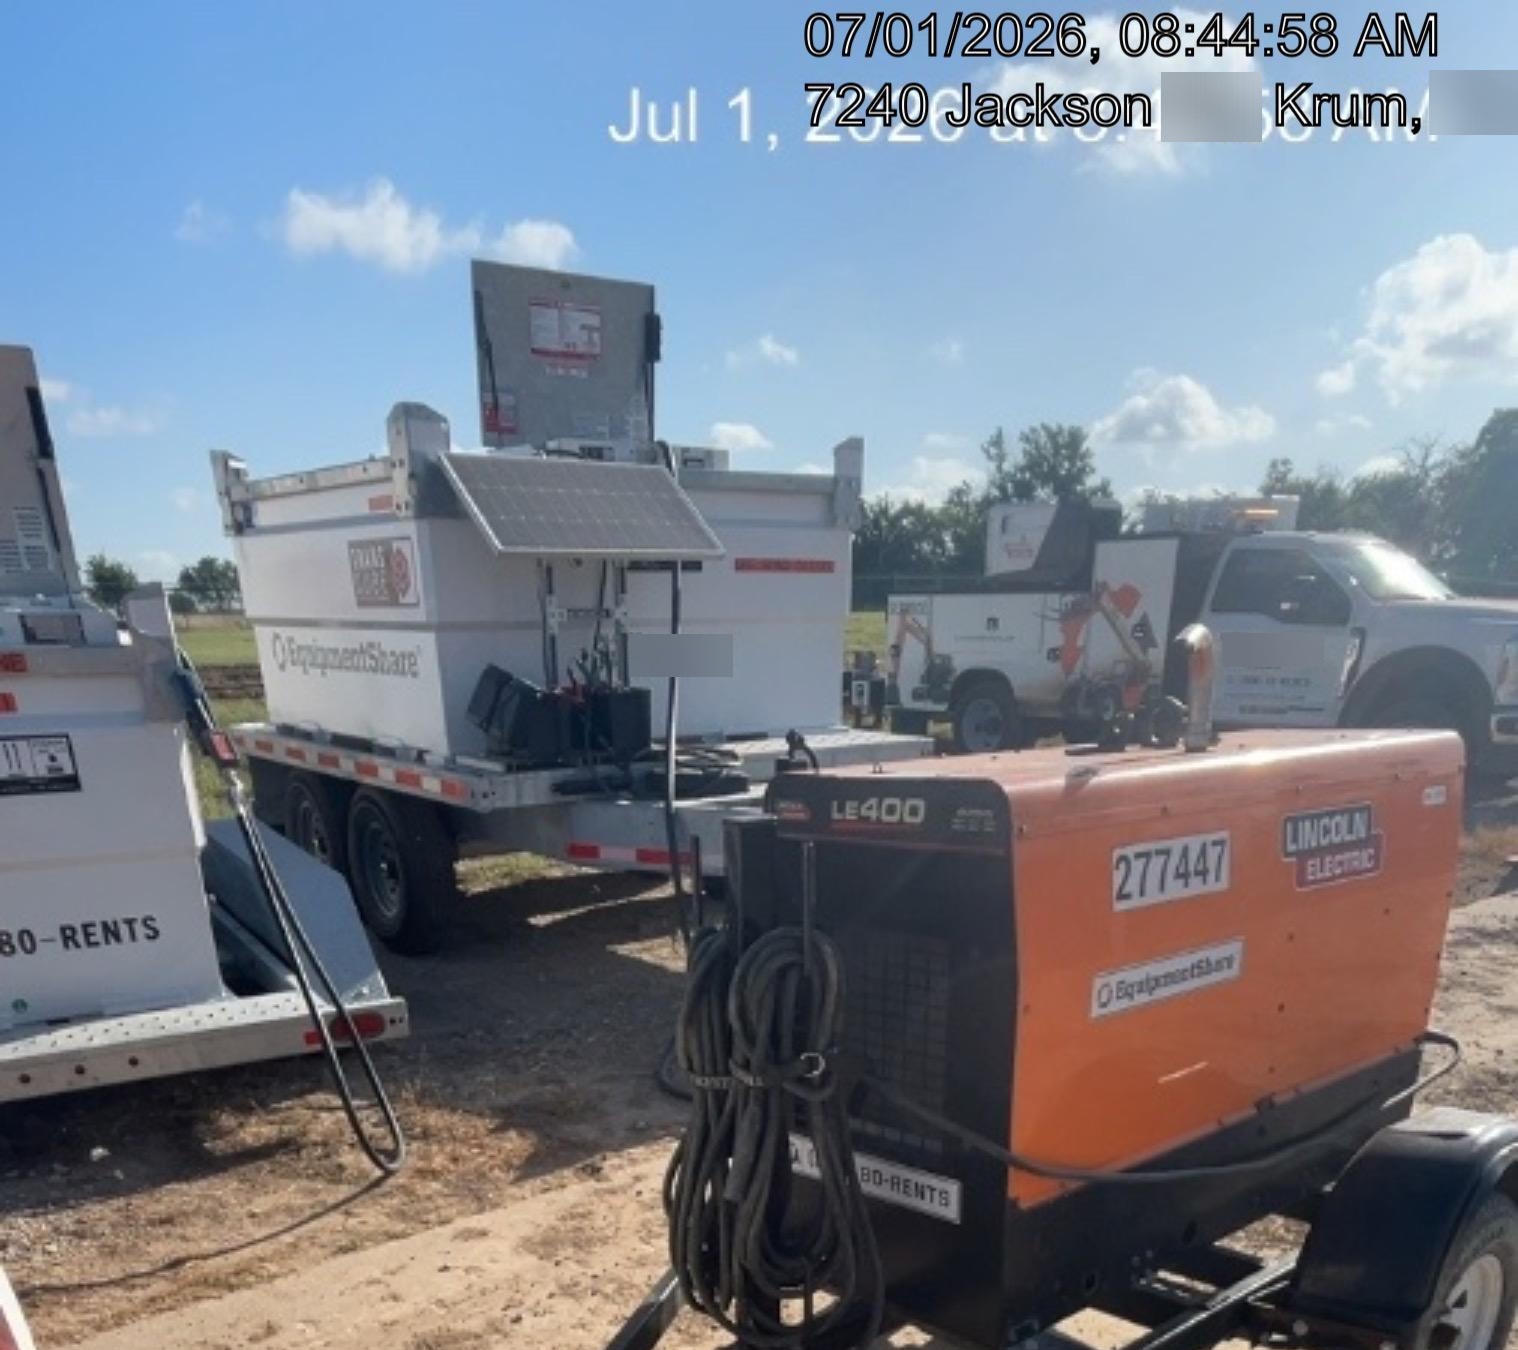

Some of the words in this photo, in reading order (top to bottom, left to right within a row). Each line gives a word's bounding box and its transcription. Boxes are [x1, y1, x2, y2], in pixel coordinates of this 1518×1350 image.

[831, 797, 926, 823] LE400
[1286, 810, 1368, 853] LINCOLN
[1114, 839, 1227, 901] 277447
[1307, 848, 1376, 880] ELECTRIC
